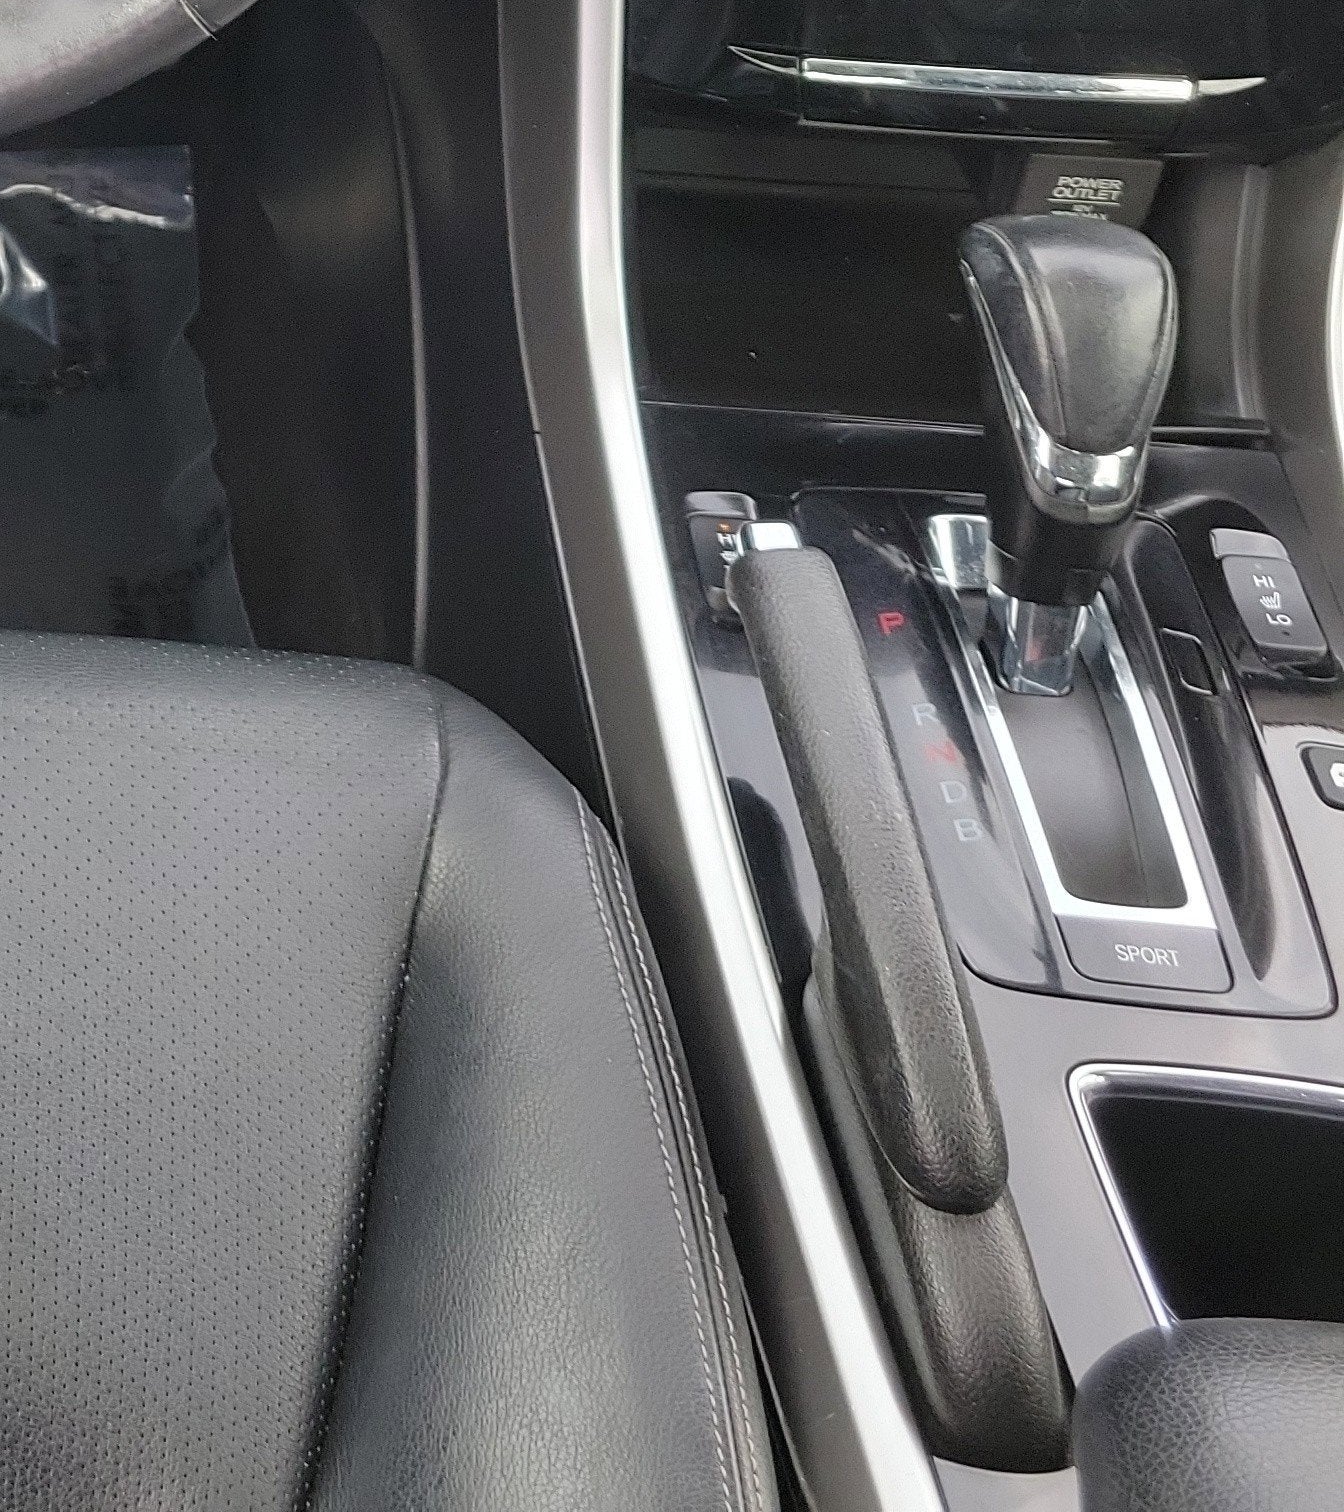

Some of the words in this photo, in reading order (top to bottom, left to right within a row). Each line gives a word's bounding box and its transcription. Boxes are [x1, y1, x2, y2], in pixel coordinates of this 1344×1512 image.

[1052, 187, 1122, 201] OUTLET
[1056, 176, 1124, 190] POWER
[1252, 574, 1276, 588] HI
[877, 610, 905, 635] P
[1265, 612, 1293, 626] LO
[912, 702, 940, 726] R
[939, 780, 967, 804] D
[953, 818, 983, 842] B
[1114, 943, 1179, 967] SPORT
